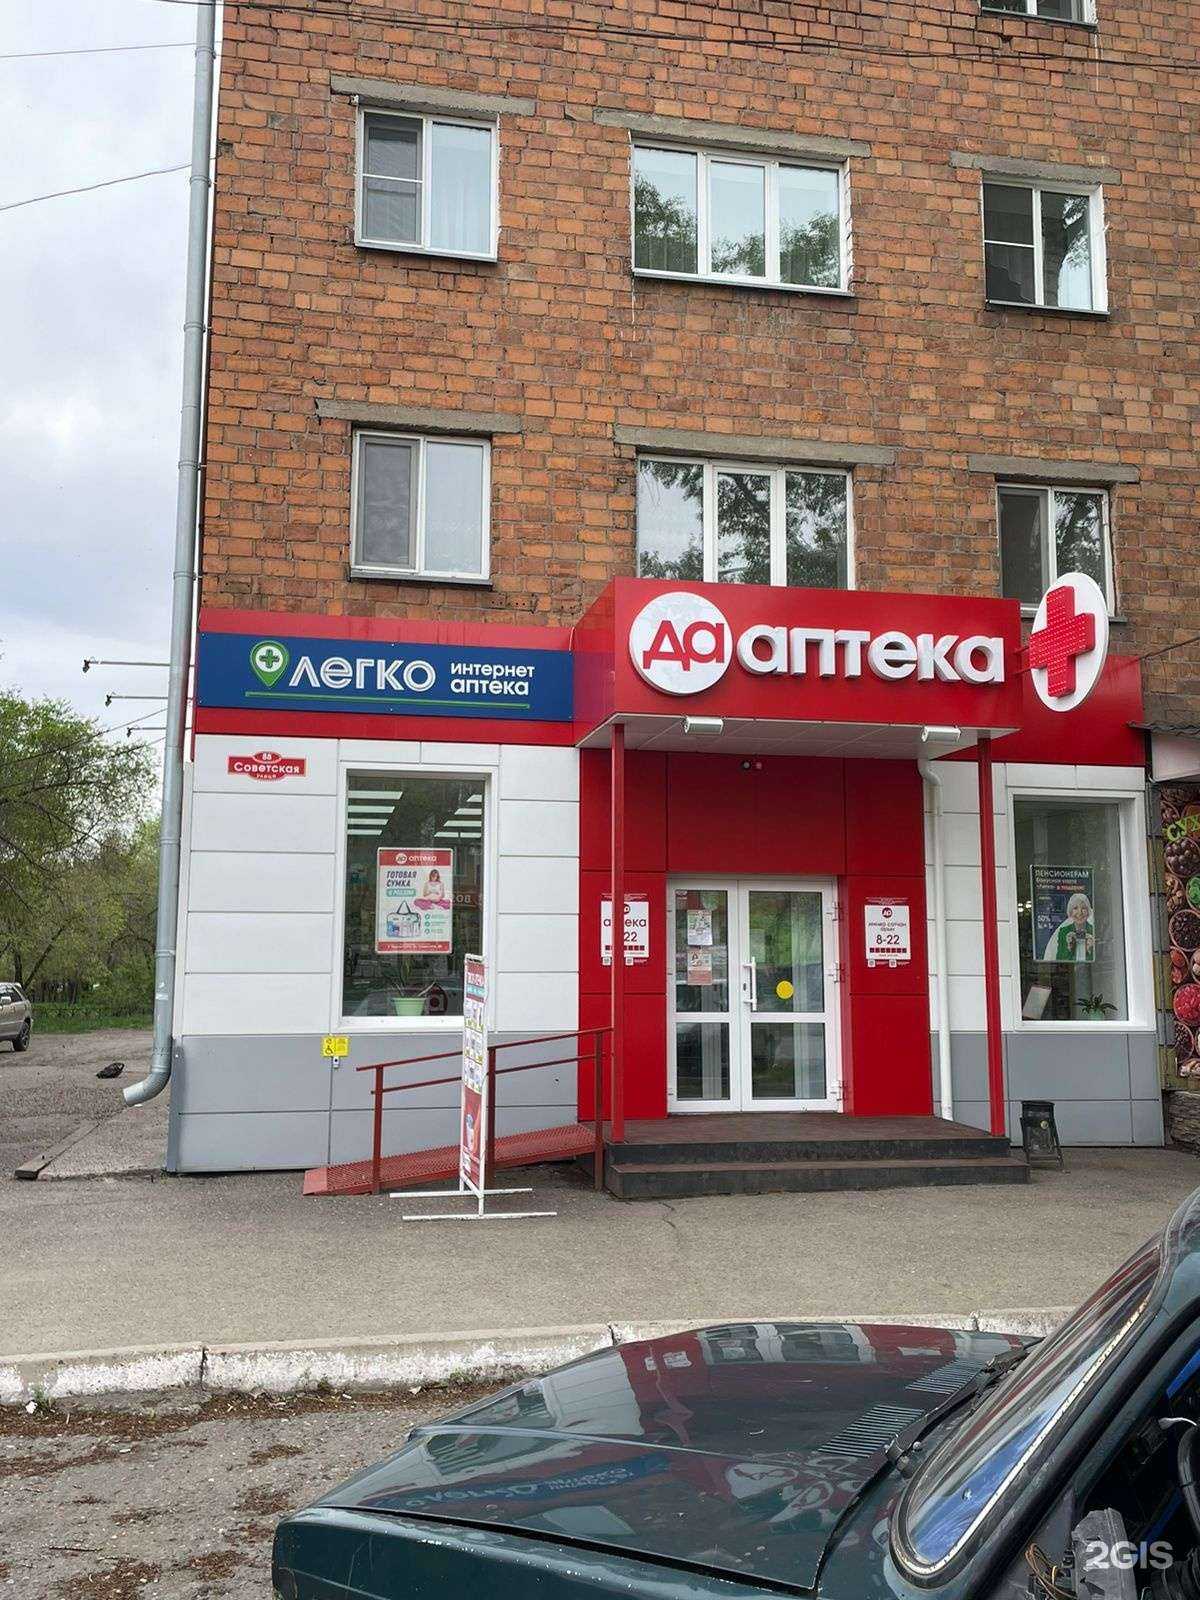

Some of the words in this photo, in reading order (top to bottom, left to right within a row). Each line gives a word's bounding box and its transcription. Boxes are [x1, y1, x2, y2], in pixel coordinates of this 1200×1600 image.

[736, 624, 1005, 684] аптека
[450, 661, 535, 679] интернет
[450, 678, 529, 696] аптека
[234, 762, 299, 773] Советская
[386, 870, 418, 879] ГОТОВАЯ
[1035, 869, 1089, 878] ПЕНСИОНЕРАМ
[603, 919, 647, 927] аека
[876, 934, 900, 945] 8-22
